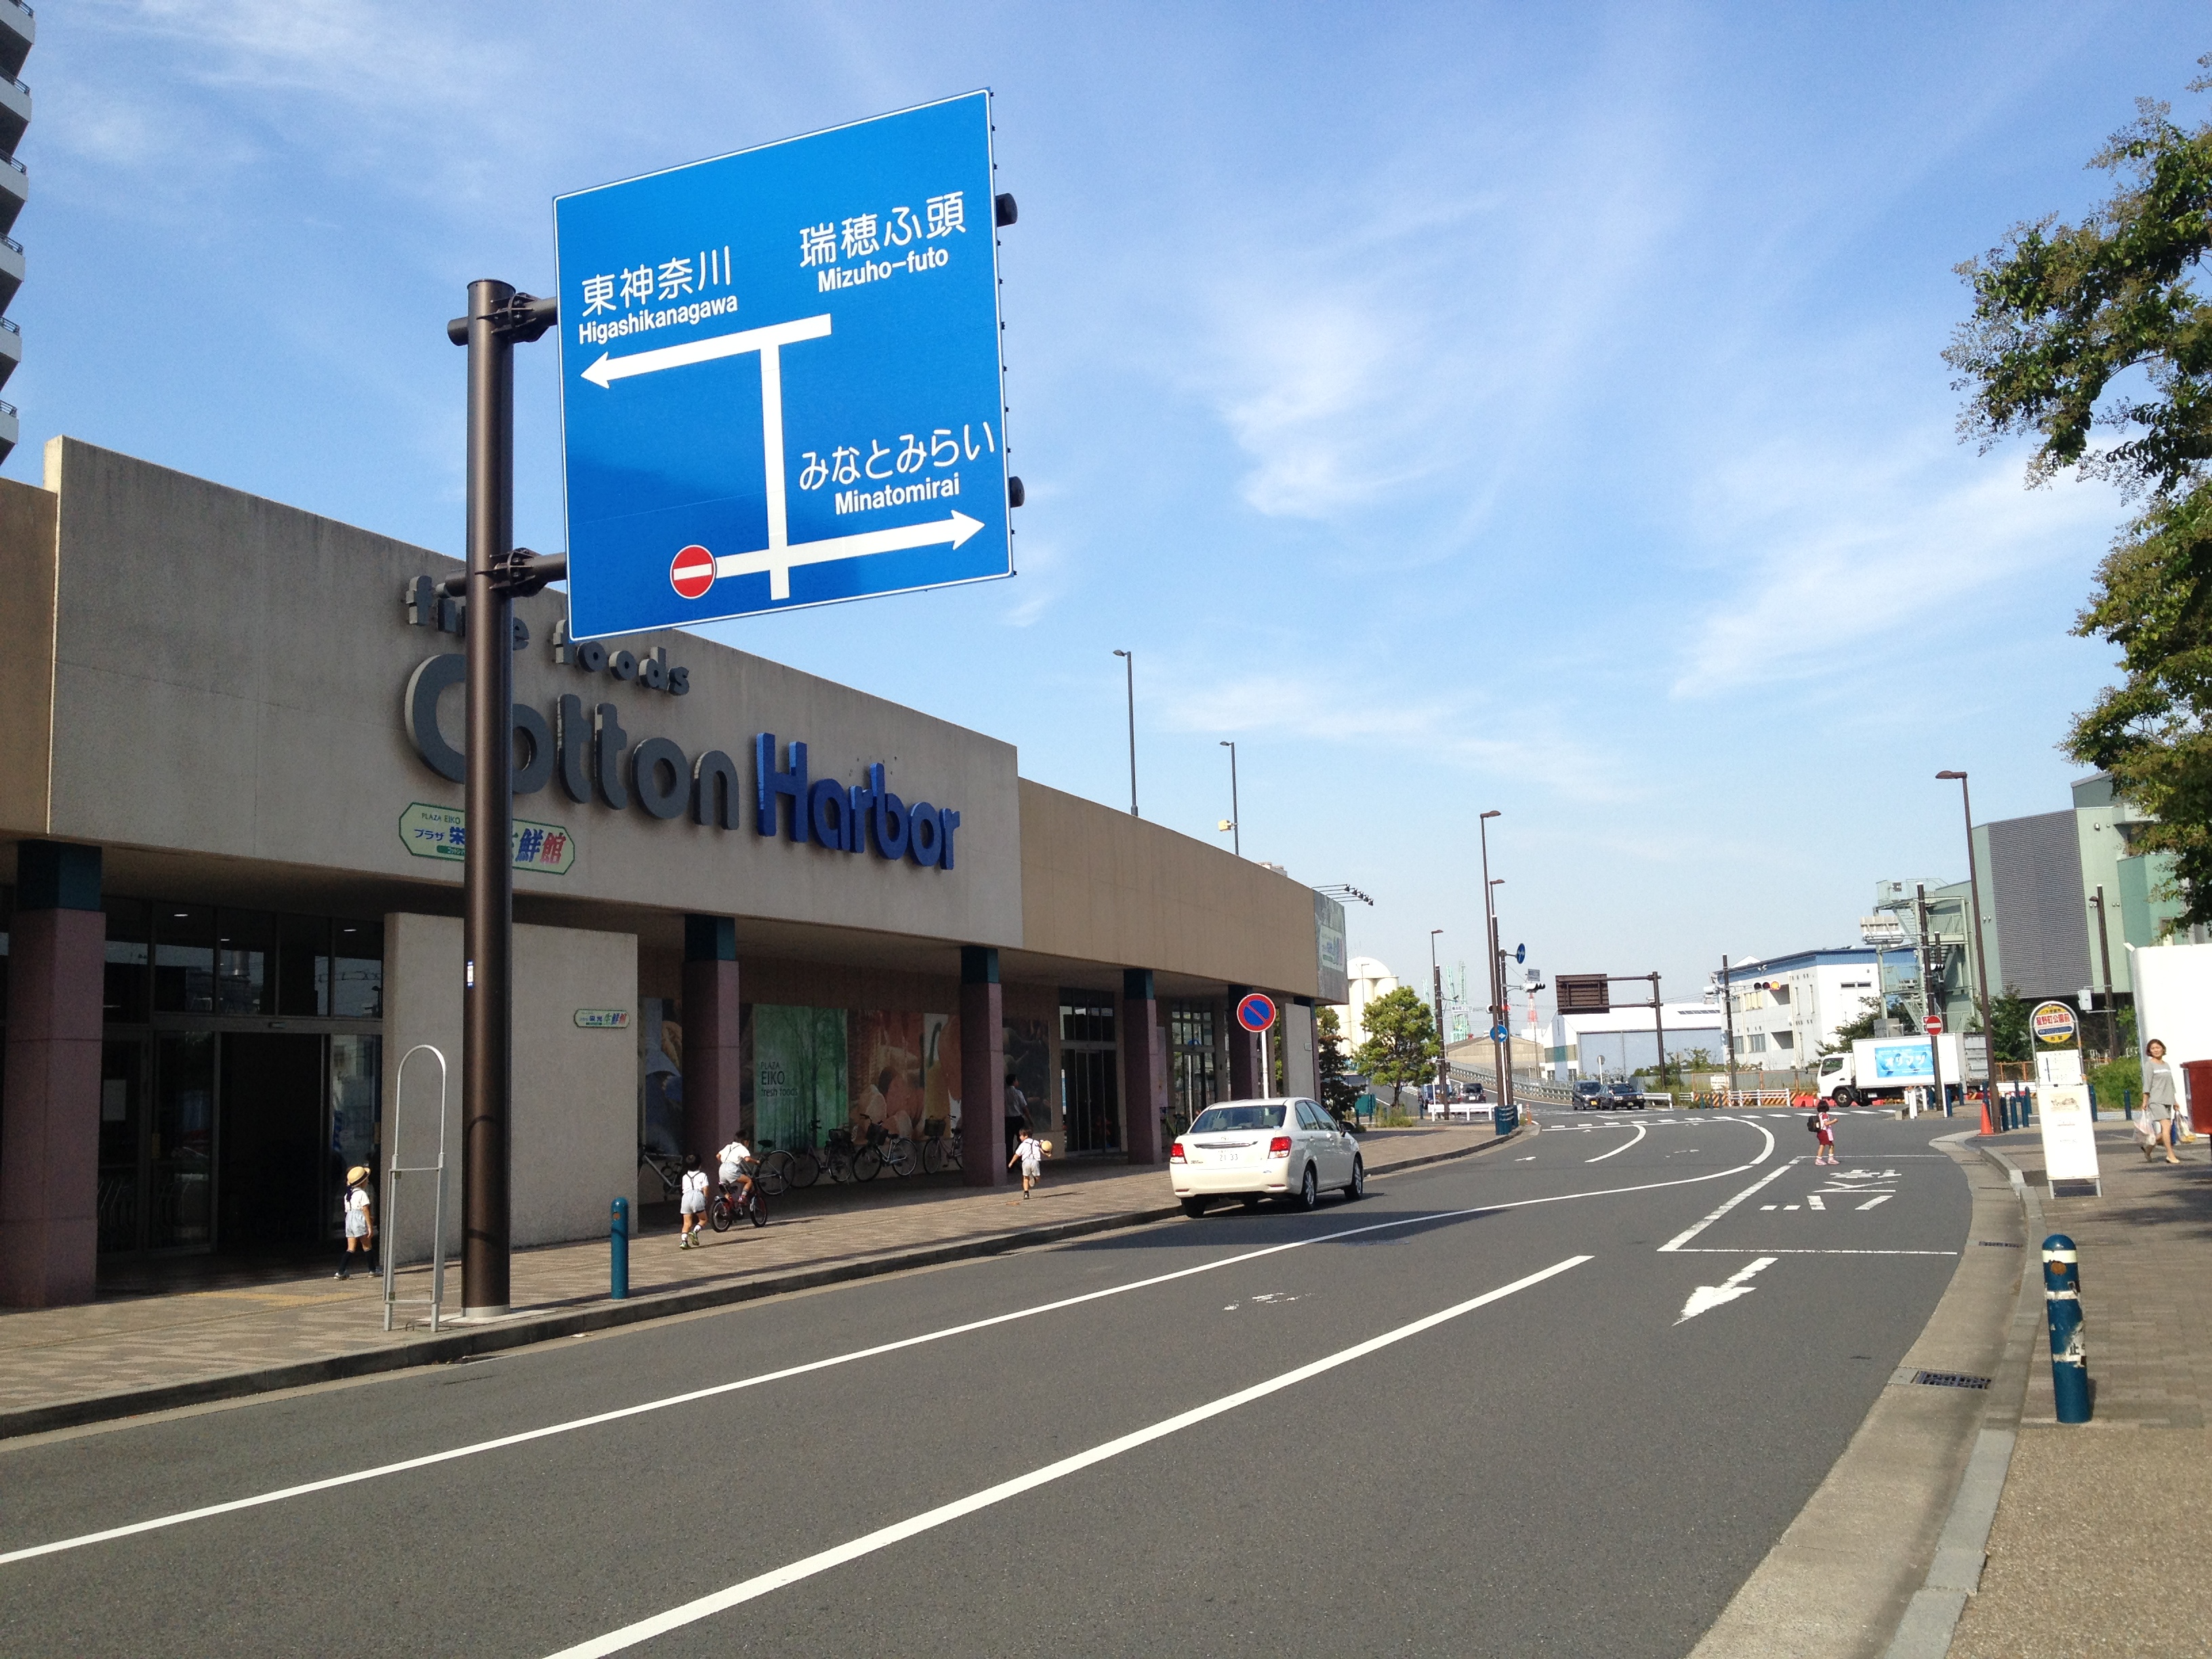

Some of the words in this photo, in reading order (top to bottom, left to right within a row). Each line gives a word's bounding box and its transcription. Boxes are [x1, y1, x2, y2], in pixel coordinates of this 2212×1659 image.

[800, 191, 966, 268] 瑞穂ふ頭
[581, 245, 732, 317] 東神奈川
[817, 246, 949, 293] Mizuho-futo
[579, 294, 738, 345] Higashikanagawa
[800, 422, 995, 491] みなとみらい
[835, 473, 960, 515] Minatomirai
[405, 654, 739, 831] Cotton
[756, 733, 960, 871] Harbor
[422, 813, 441, 822] PLAZA
[445, 815, 461, 825] EIKO
[760, 1061, 780, 1069] PLAZA
[761, 1071, 785, 1085] EIKO
